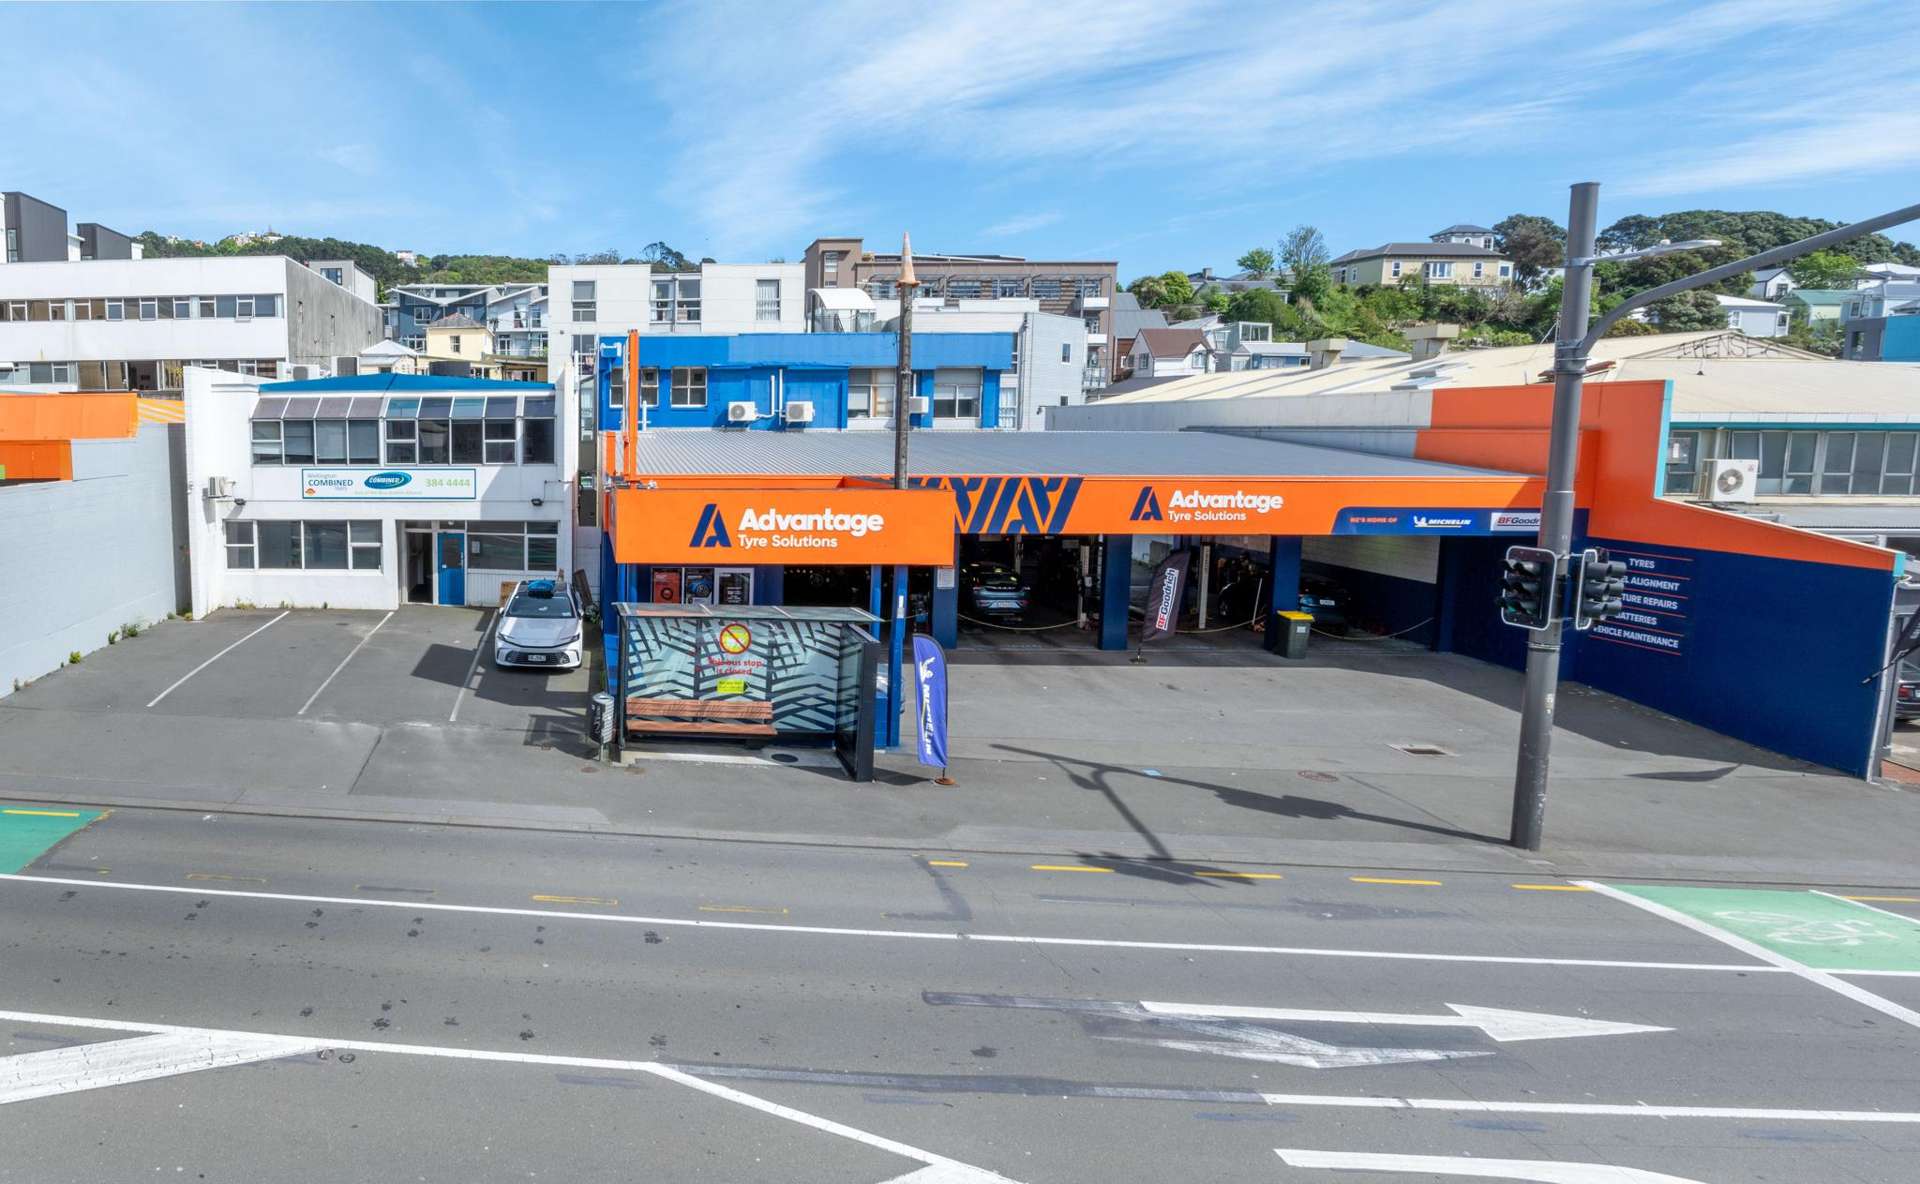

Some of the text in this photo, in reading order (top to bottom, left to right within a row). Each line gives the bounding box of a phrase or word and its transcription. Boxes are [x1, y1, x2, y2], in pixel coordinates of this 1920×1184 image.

[308, 479, 353, 487] COMBINED
[425, 478, 471, 488] 384 4444
[1169, 490, 1284, 513] Advantage
[738, 508, 884, 537] Advantage
[1168, 511, 1246, 523] Tyre Solutions
[1428, 518, 1472, 526] MICHELIN
[1497, 516, 1540, 524] BFGoodr
[738, 535, 838, 549] Tyre Solutions
[1629, 558, 1655, 569] TYRES
[1630, 576, 1680, 591] ALIGNMENT
[1157, 568, 1177, 629] BFGoodrich
[1621, 593, 1678, 610] TURE REPAIRS
[1623, 631, 1679, 648] MAINTENANCE
[743, 659, 762, 668] stop
